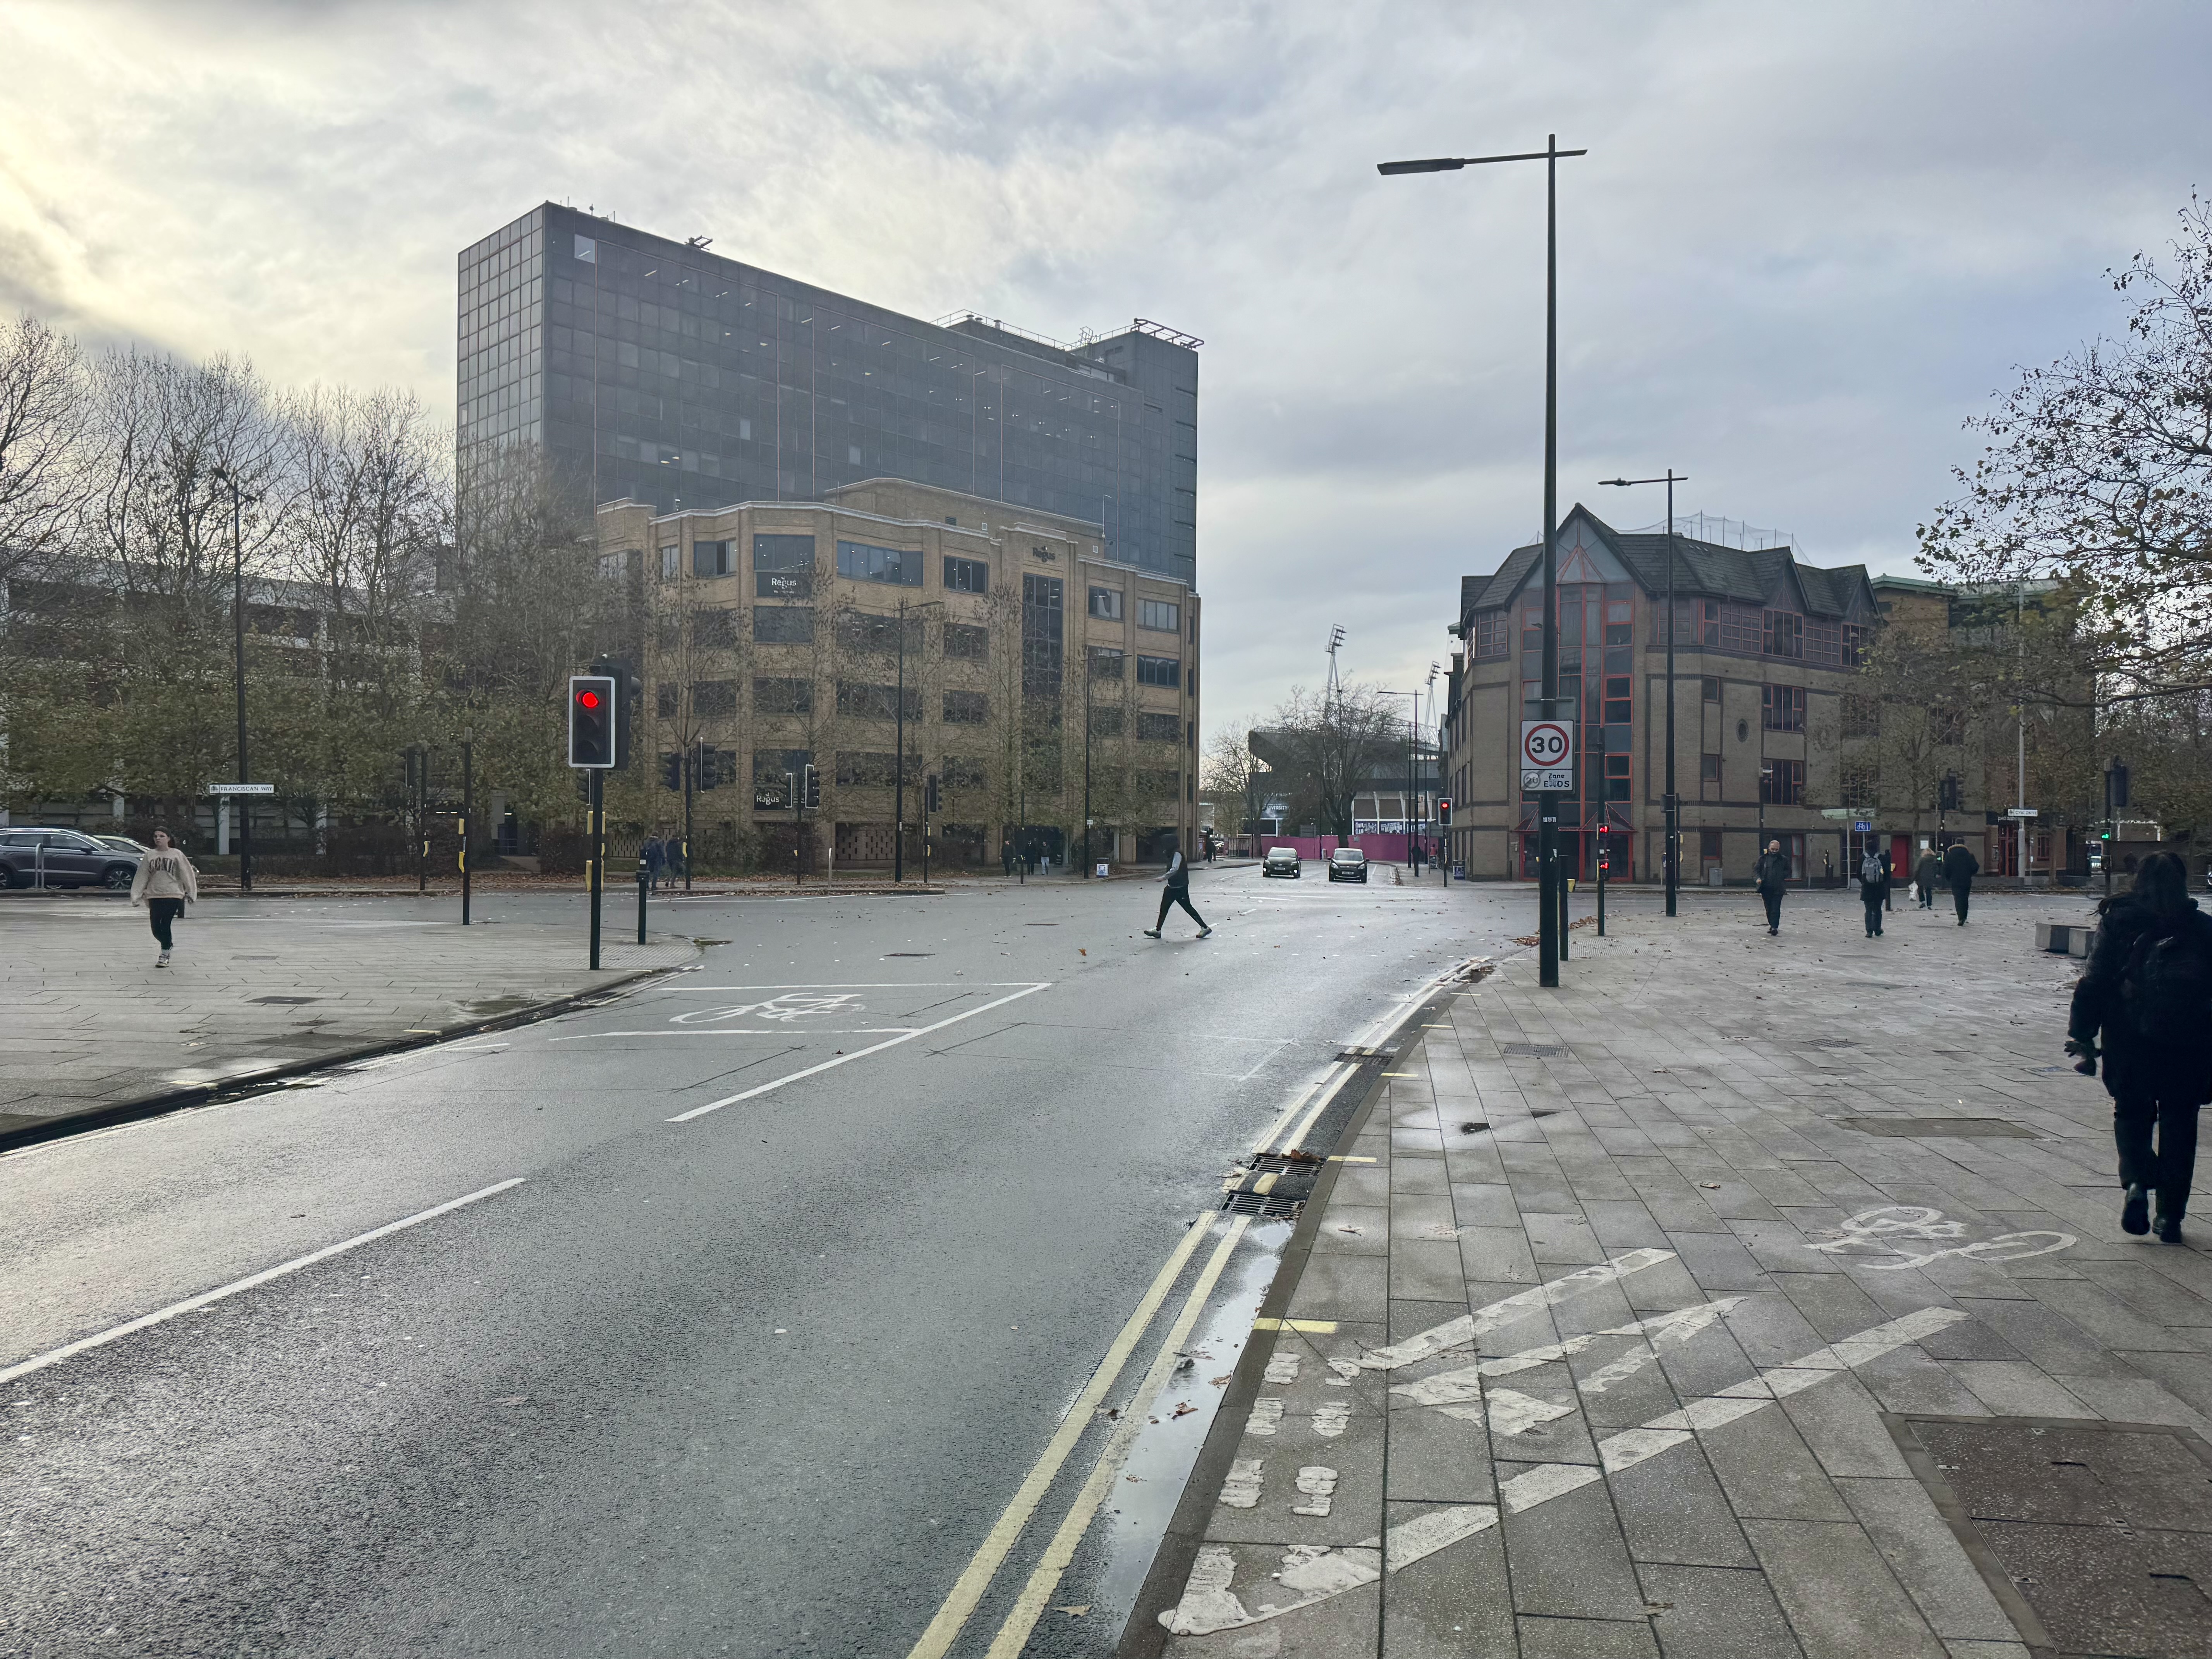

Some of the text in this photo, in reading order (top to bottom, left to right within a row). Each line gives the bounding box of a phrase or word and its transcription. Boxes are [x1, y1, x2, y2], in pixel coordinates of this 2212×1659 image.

[1033, 547, 1056, 562] Regus
[771, 578, 797, 589] Regus
[1532, 736, 1563, 753] 30
[756, 795, 780, 805] Regus
